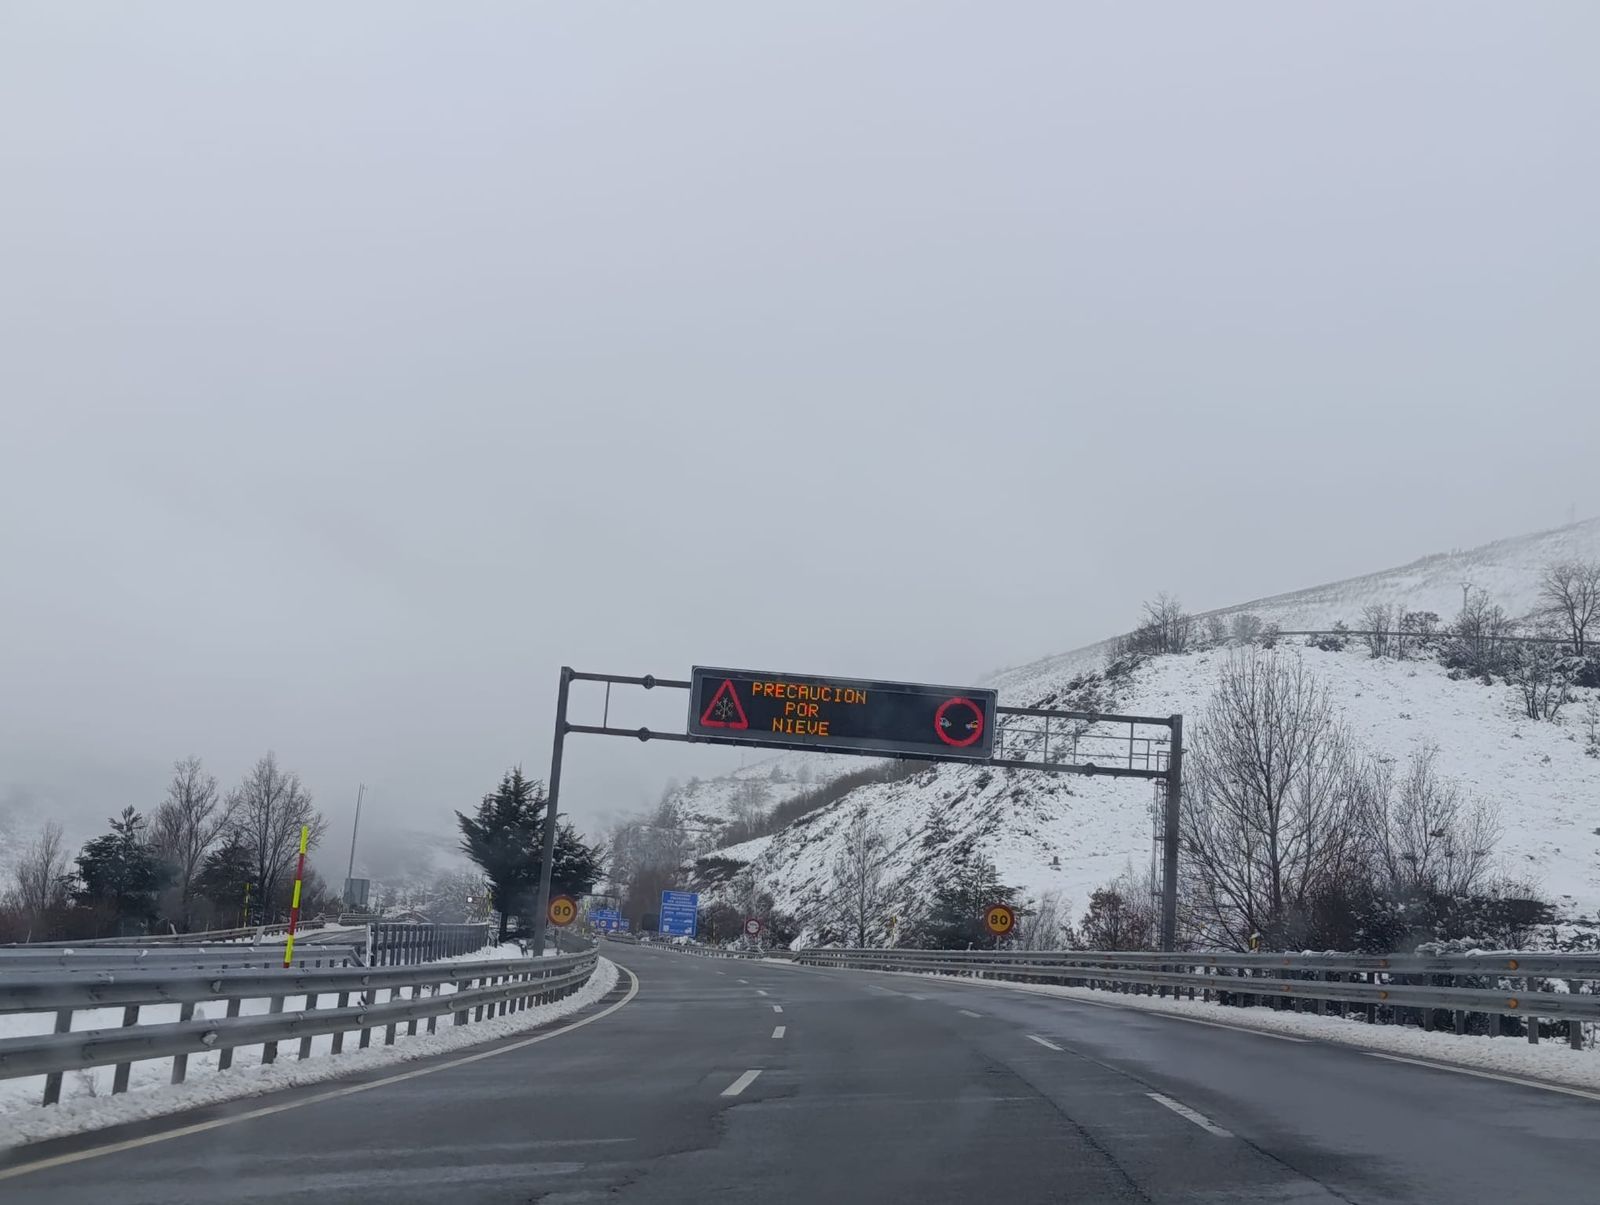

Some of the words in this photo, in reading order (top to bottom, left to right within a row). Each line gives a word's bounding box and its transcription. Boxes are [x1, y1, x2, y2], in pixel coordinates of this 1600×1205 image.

[752, 682, 866, 704] PRECAUCION
[785, 702, 819, 717] POR
[773, 718, 829, 736] NIEVE
[554, 905, 571, 916] 80
[991, 915, 1008, 925] 80
